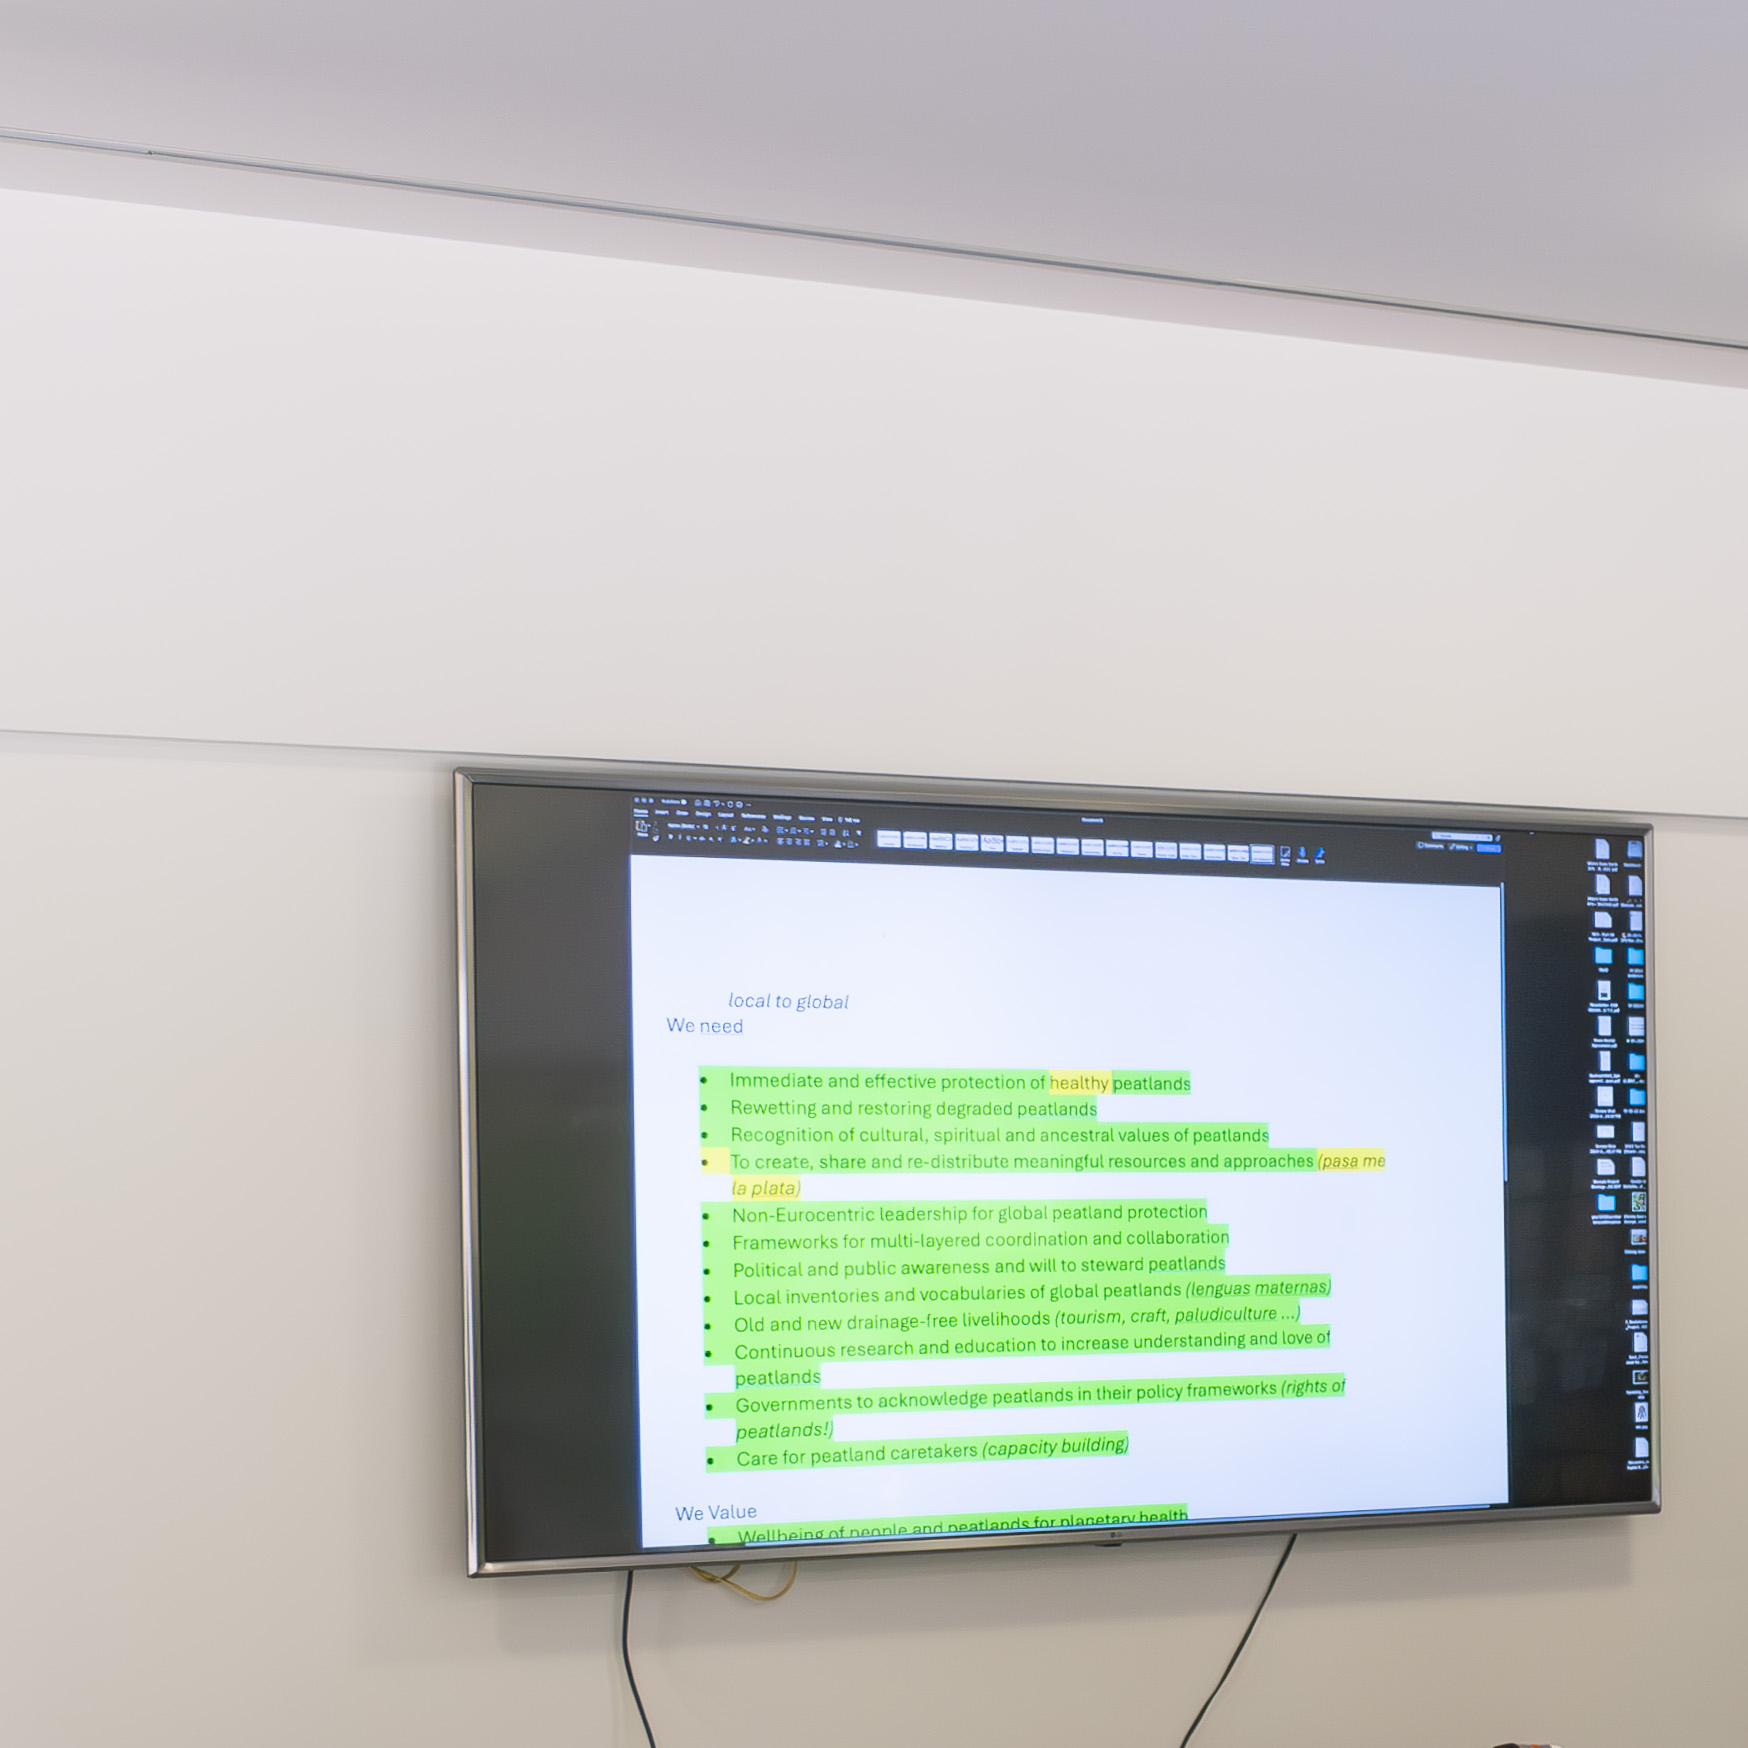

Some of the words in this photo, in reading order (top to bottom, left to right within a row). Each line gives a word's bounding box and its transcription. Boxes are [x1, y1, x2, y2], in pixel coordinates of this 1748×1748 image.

[728, 993, 771, 1009] local
[775, 994, 792, 1009] to
[796, 994, 849, 1012] global
[666, 1016, 695, 1032] We
[700, 1017, 743, 1033] need
[730, 1073, 823, 1088] Immediate
[828, 1073, 860, 1089] and
[864, 1074, 937, 1089] effective
[941, 1074, 1026, 1093] protection
[1030, 1075, 1046, 1090] of
[1050, 1075, 1109, 1093] healthy
[1112, 1075, 1191, 1094] peatlands
[730, 1100, 817, 1118] Rewetting
[820, 1100, 853, 1115] and
[858, 1100, 932, 1119] restoring
[936, 1101, 1013, 1119] degraded
[1017, 1101, 1098, 1120] peatlands
[731, 1127, 834, 1145] Recognition
[838, 1127, 855, 1142] of
[859, 1127, 929, 1145] cultural,
[934, 1127, 1001, 1146] spiritual
[1005, 1127, 1036, 1143] and
[1040, 1127, 1115, 1143] ancestral
[1117, 1128, 1170, 1143] values
[1173, 1128, 1189, 1143] of
[1192, 1128, 1270, 1146] peatlands
[730, 1154, 750, 1169] To
[754, 1154, 814, 1172] create,
[818, 1154, 866, 1169] share
[871, 1154, 902, 1169] and
[907, 1153, 1009, 1169] re-distribute
[1013, 1153, 1104, 1172] meaningful
[1108, 1155, 1186, 1168] resources
[1190, 1153, 1219, 1168] and
[1223, 1152, 1314, 1171] approaches
[1317, 1152, 1359, 1170] (pasa
[1362, 1155, 1386, 1167] me
[731, 1180, 747, 1195] la
[751, 1180, 801, 1198] plata)
[732, 1207, 875, 1224] Non-Eurocentric
[879, 1206, 968, 1225] leadership
[971, 1205, 994, 1221] for
[998, 1205, 1048, 1223] global
[1052, 1204, 1123, 1223] peatland
[1127, 1203, 1208, 1222] protection
[732, 1234, 839, 1251] Frameworks
[842, 1234, 866, 1249] for
[870, 1232, 980, 1252] multi-layered
[985, 1231, 1088, 1247] coordination
[1092, 1230, 1122, 1245] and
[1126, 1229, 1230, 1245] collaboration
[733, 1261, 802, 1277] Political
[807, 1261, 839, 1276] and
[844, 1260, 896, 1279] public
[900, 1261, 990, 1275] awareness
[994, 1257, 1025, 1273] and
[1028, 1257, 1056, 1272] will
[1060, 1256, 1077, 1272] to
[1080, 1256, 1144, 1272] steward
[1148, 1255, 1226, 1274] peatlands
[734, 1290, 781, 1306] Local
[786, 1288, 880, 1304] inventories
[884, 1287, 915, 1302] and
[919, 1285, 1026, 1302] vocabularies
[1030, 1284, 1046, 1299] of
[1049, 1283, 1099, 1302] global
[1103, 1281, 1182, 1301] peatlands
[1185, 1280, 1251, 1300] (lenguas
[1254, 1279, 1332, 1298] maternas)
[734, 1317, 765, 1332] Old
[770, 1316, 802, 1332] and
[807, 1318, 842, 1331] new
[846, 1313, 958, 1333] drainage-free
[962, 1311, 1051, 1327] livelihoods
[1054, 1309, 1126, 1328] (tourism,
[1130, 1308, 1170, 1327] craft,
[1174, 1306, 1278, 1326] paludiculture
[734, 1342, 836, 1360] Continuous
[840, 1340, 914, 1357] research
[918, 1339, 950, 1355] and
[954, 1336, 1036, 1354] education
[1040, 1336, 1057, 1351] to
[1061, 1334, 1129, 1351] increase
[1133, 1331, 1246, 1352] understanding
[1249, 1330, 1278, 1346] and
[1282, 1329, 1313, 1345] love
[1316, 1329, 1331, 1344] of
[735, 1369, 822, 1388] peatlands
[735, 1395, 853, 1414] Governments
[856, 1394, 874, 1409] to
[878, 1390, 988, 1412] acknowledge
[992, 1387, 1074, 1407] peatlands
[1077, 1386, 1092, 1401] in
[1096, 1384, 1133, 1401] their
[1136, 1383, 1184, 1403] policy
[1186, 1380, 1277, 1398] frameworks
[1280, 1378, 1328, 1398] (rights
[1331, 1378, 1347, 1393] of
[736, 1422, 834, 1442] peatlands!)
[736, 1450, 778, 1467] Care
[782, 1449, 806, 1465] for
[810, 1446, 886, 1467] peatland
[890, 1442, 978, 1460] caretakers
[982, 1439, 1058, 1460] (capacity
[1060, 1436, 1129, 1456] building)
[674, 1504, 704, 1520] We
[707, 1503, 757, 1519] Value
